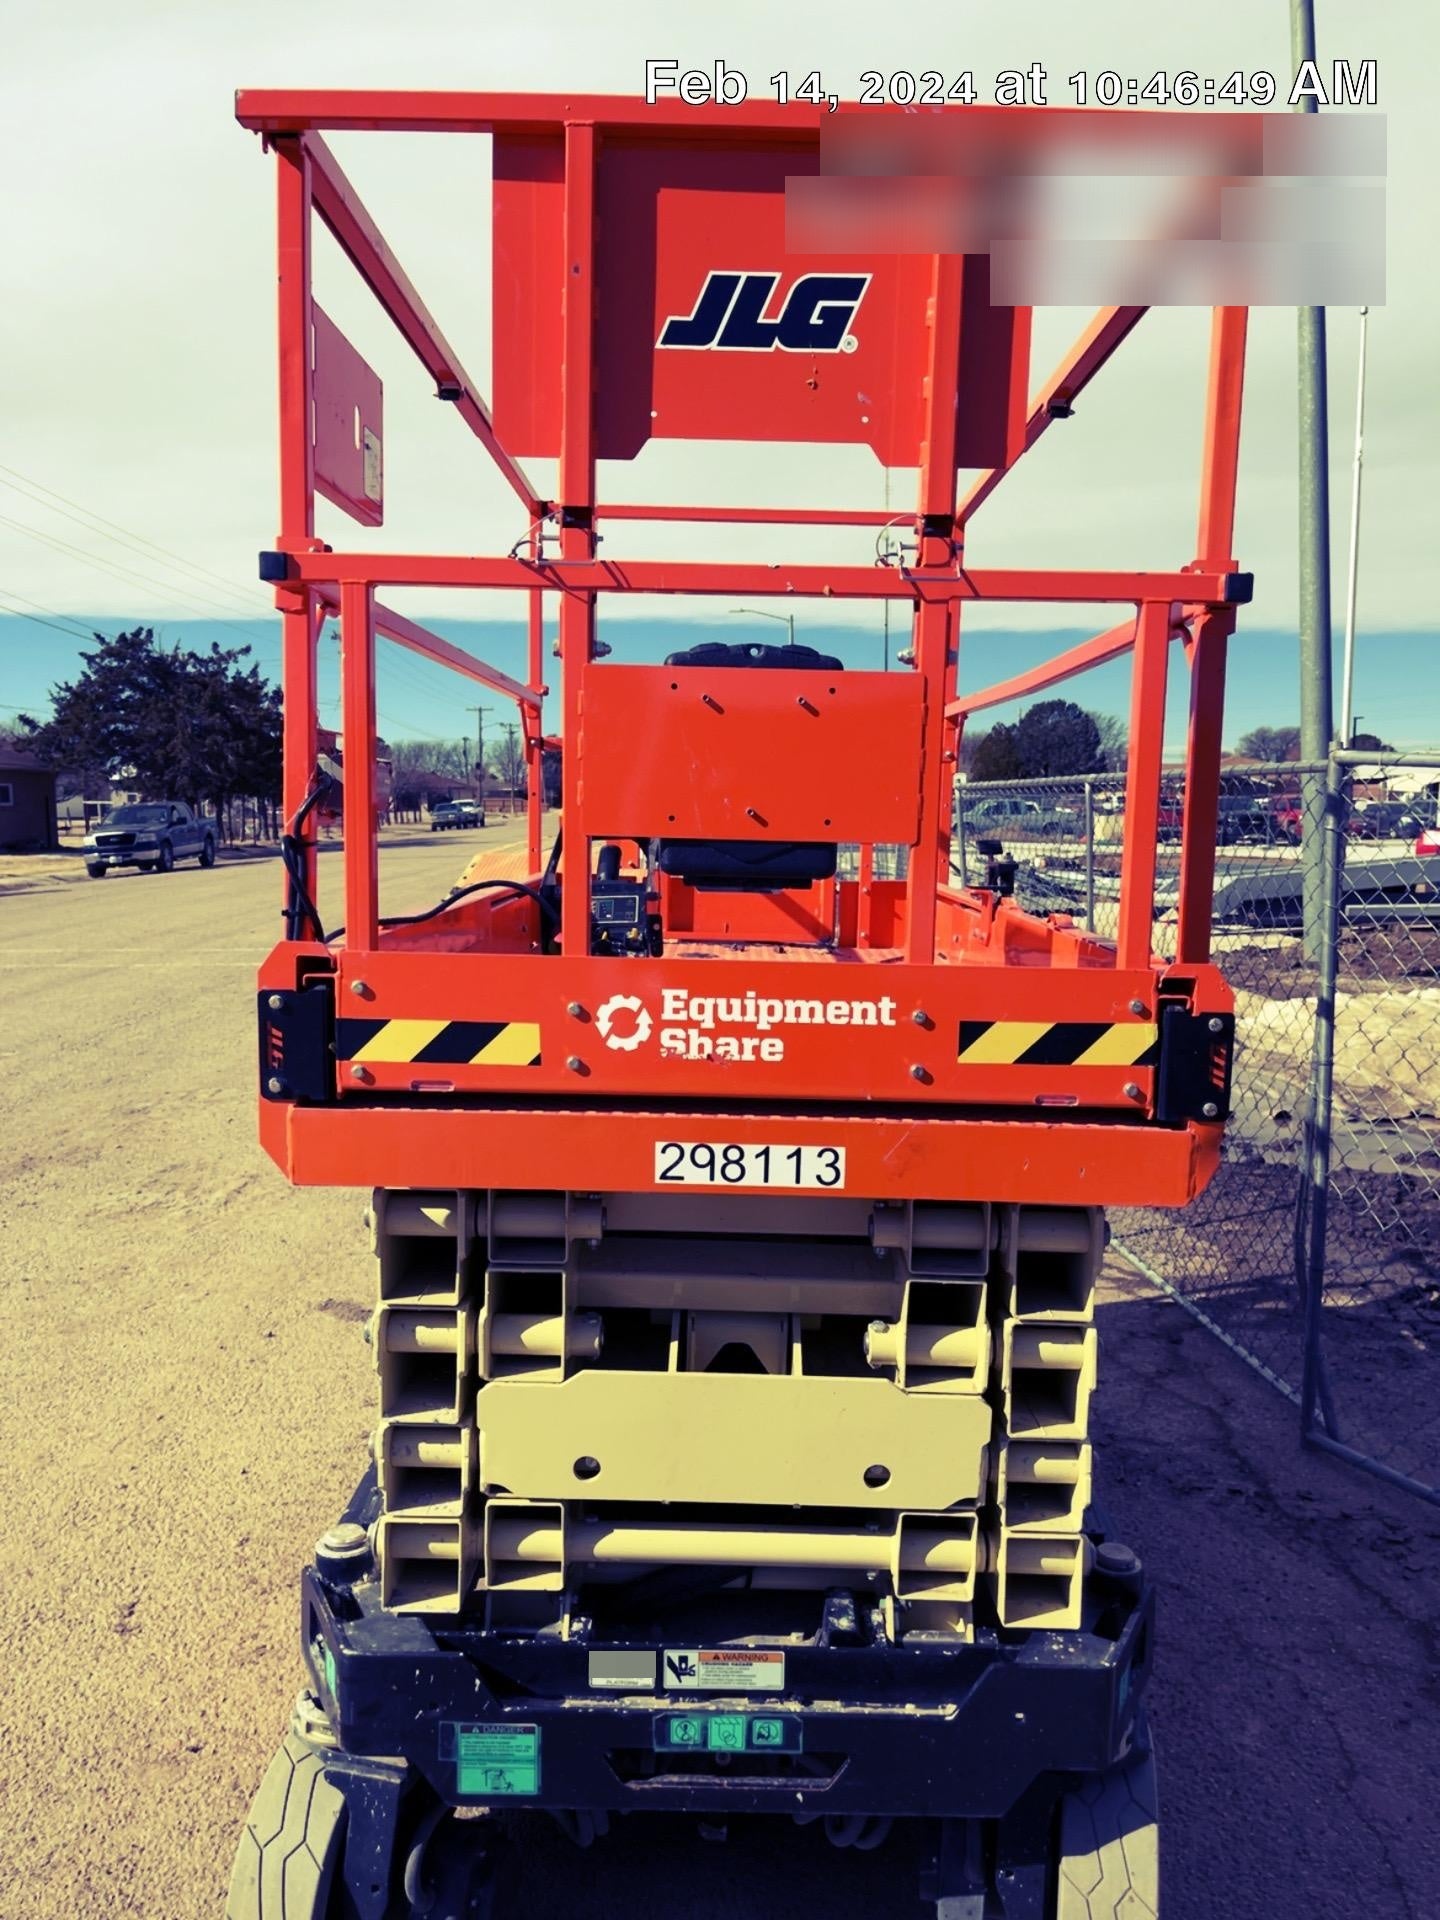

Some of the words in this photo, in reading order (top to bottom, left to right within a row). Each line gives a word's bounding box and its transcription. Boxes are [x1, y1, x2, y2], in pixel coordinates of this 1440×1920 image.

[655, 270, 873, 354] JLG
[661, 988, 897, 1030] Equipment
[660, 1027, 784, 1062] Share
[658, 1142, 842, 1187] 298113
[721, 1652, 769, 1663] WARNING
[482, 1725, 525, 1735] DANGER
